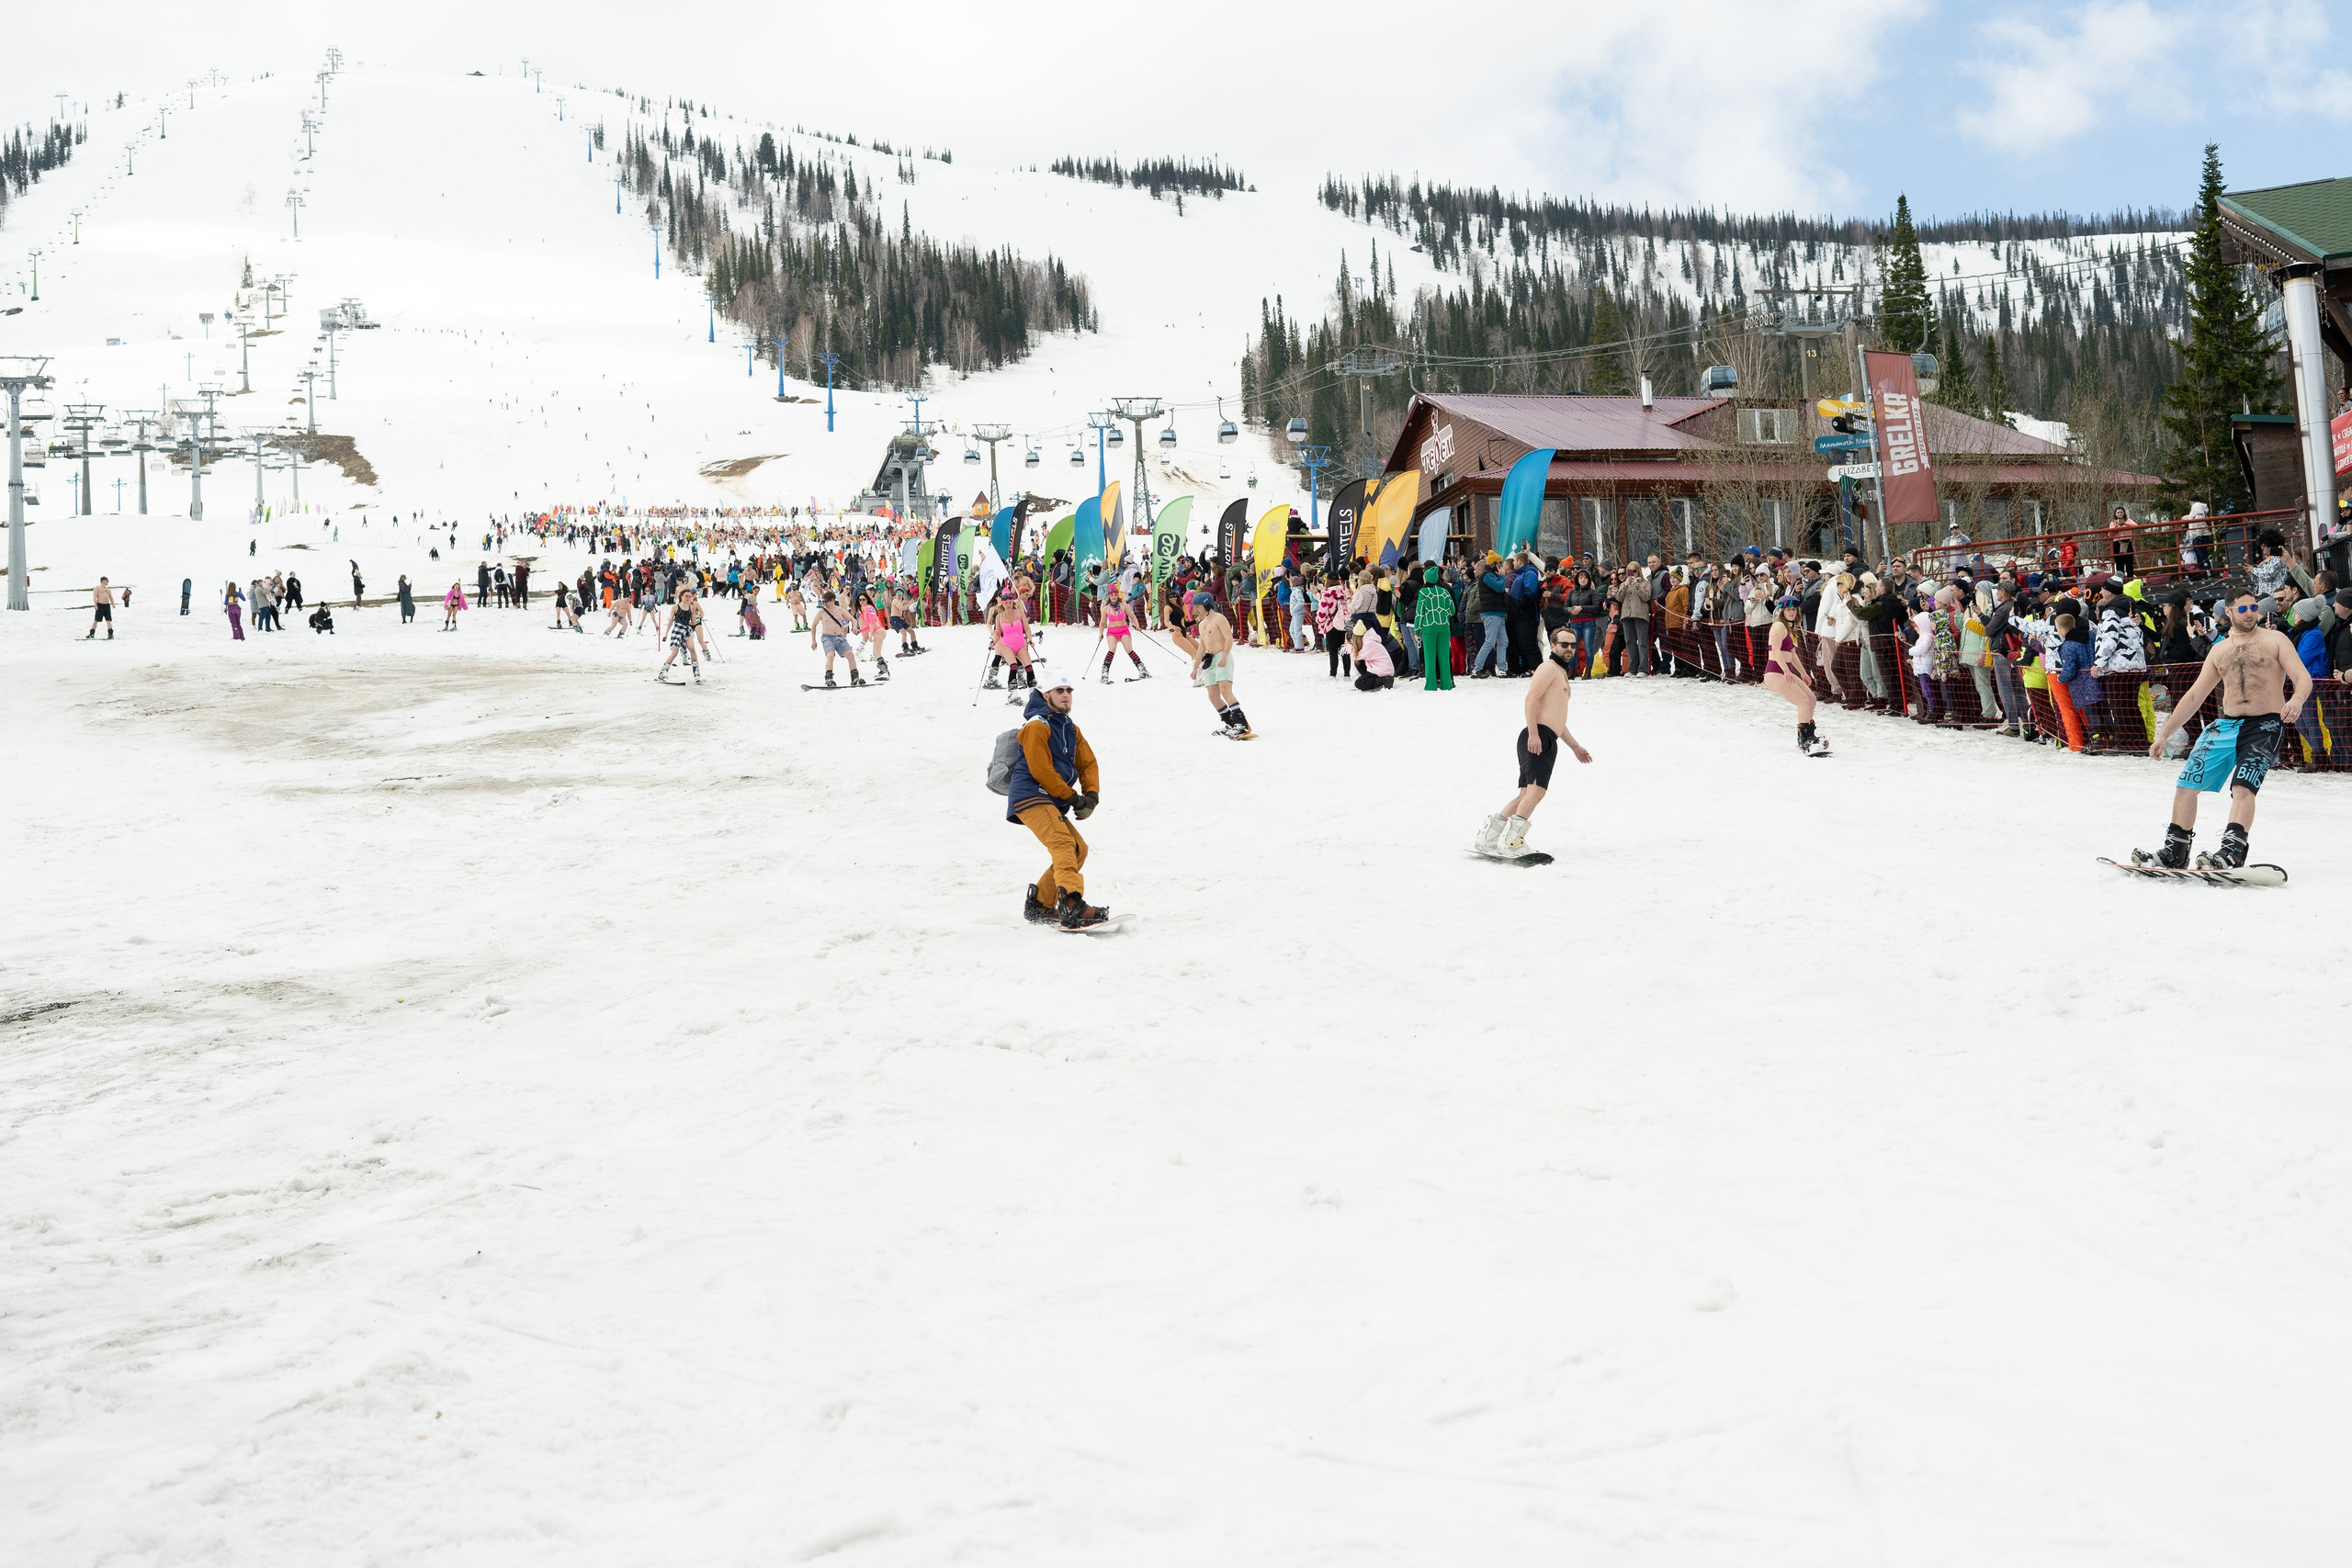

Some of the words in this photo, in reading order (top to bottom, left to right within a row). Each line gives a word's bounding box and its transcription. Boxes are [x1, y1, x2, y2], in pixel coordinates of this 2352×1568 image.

[1806, 349, 1817, 358] 13
[1883, 392, 1919, 476] GRELKA
[1819, 439, 1854, 449] Mammoth
[2178, 770, 2205, 784] ard
